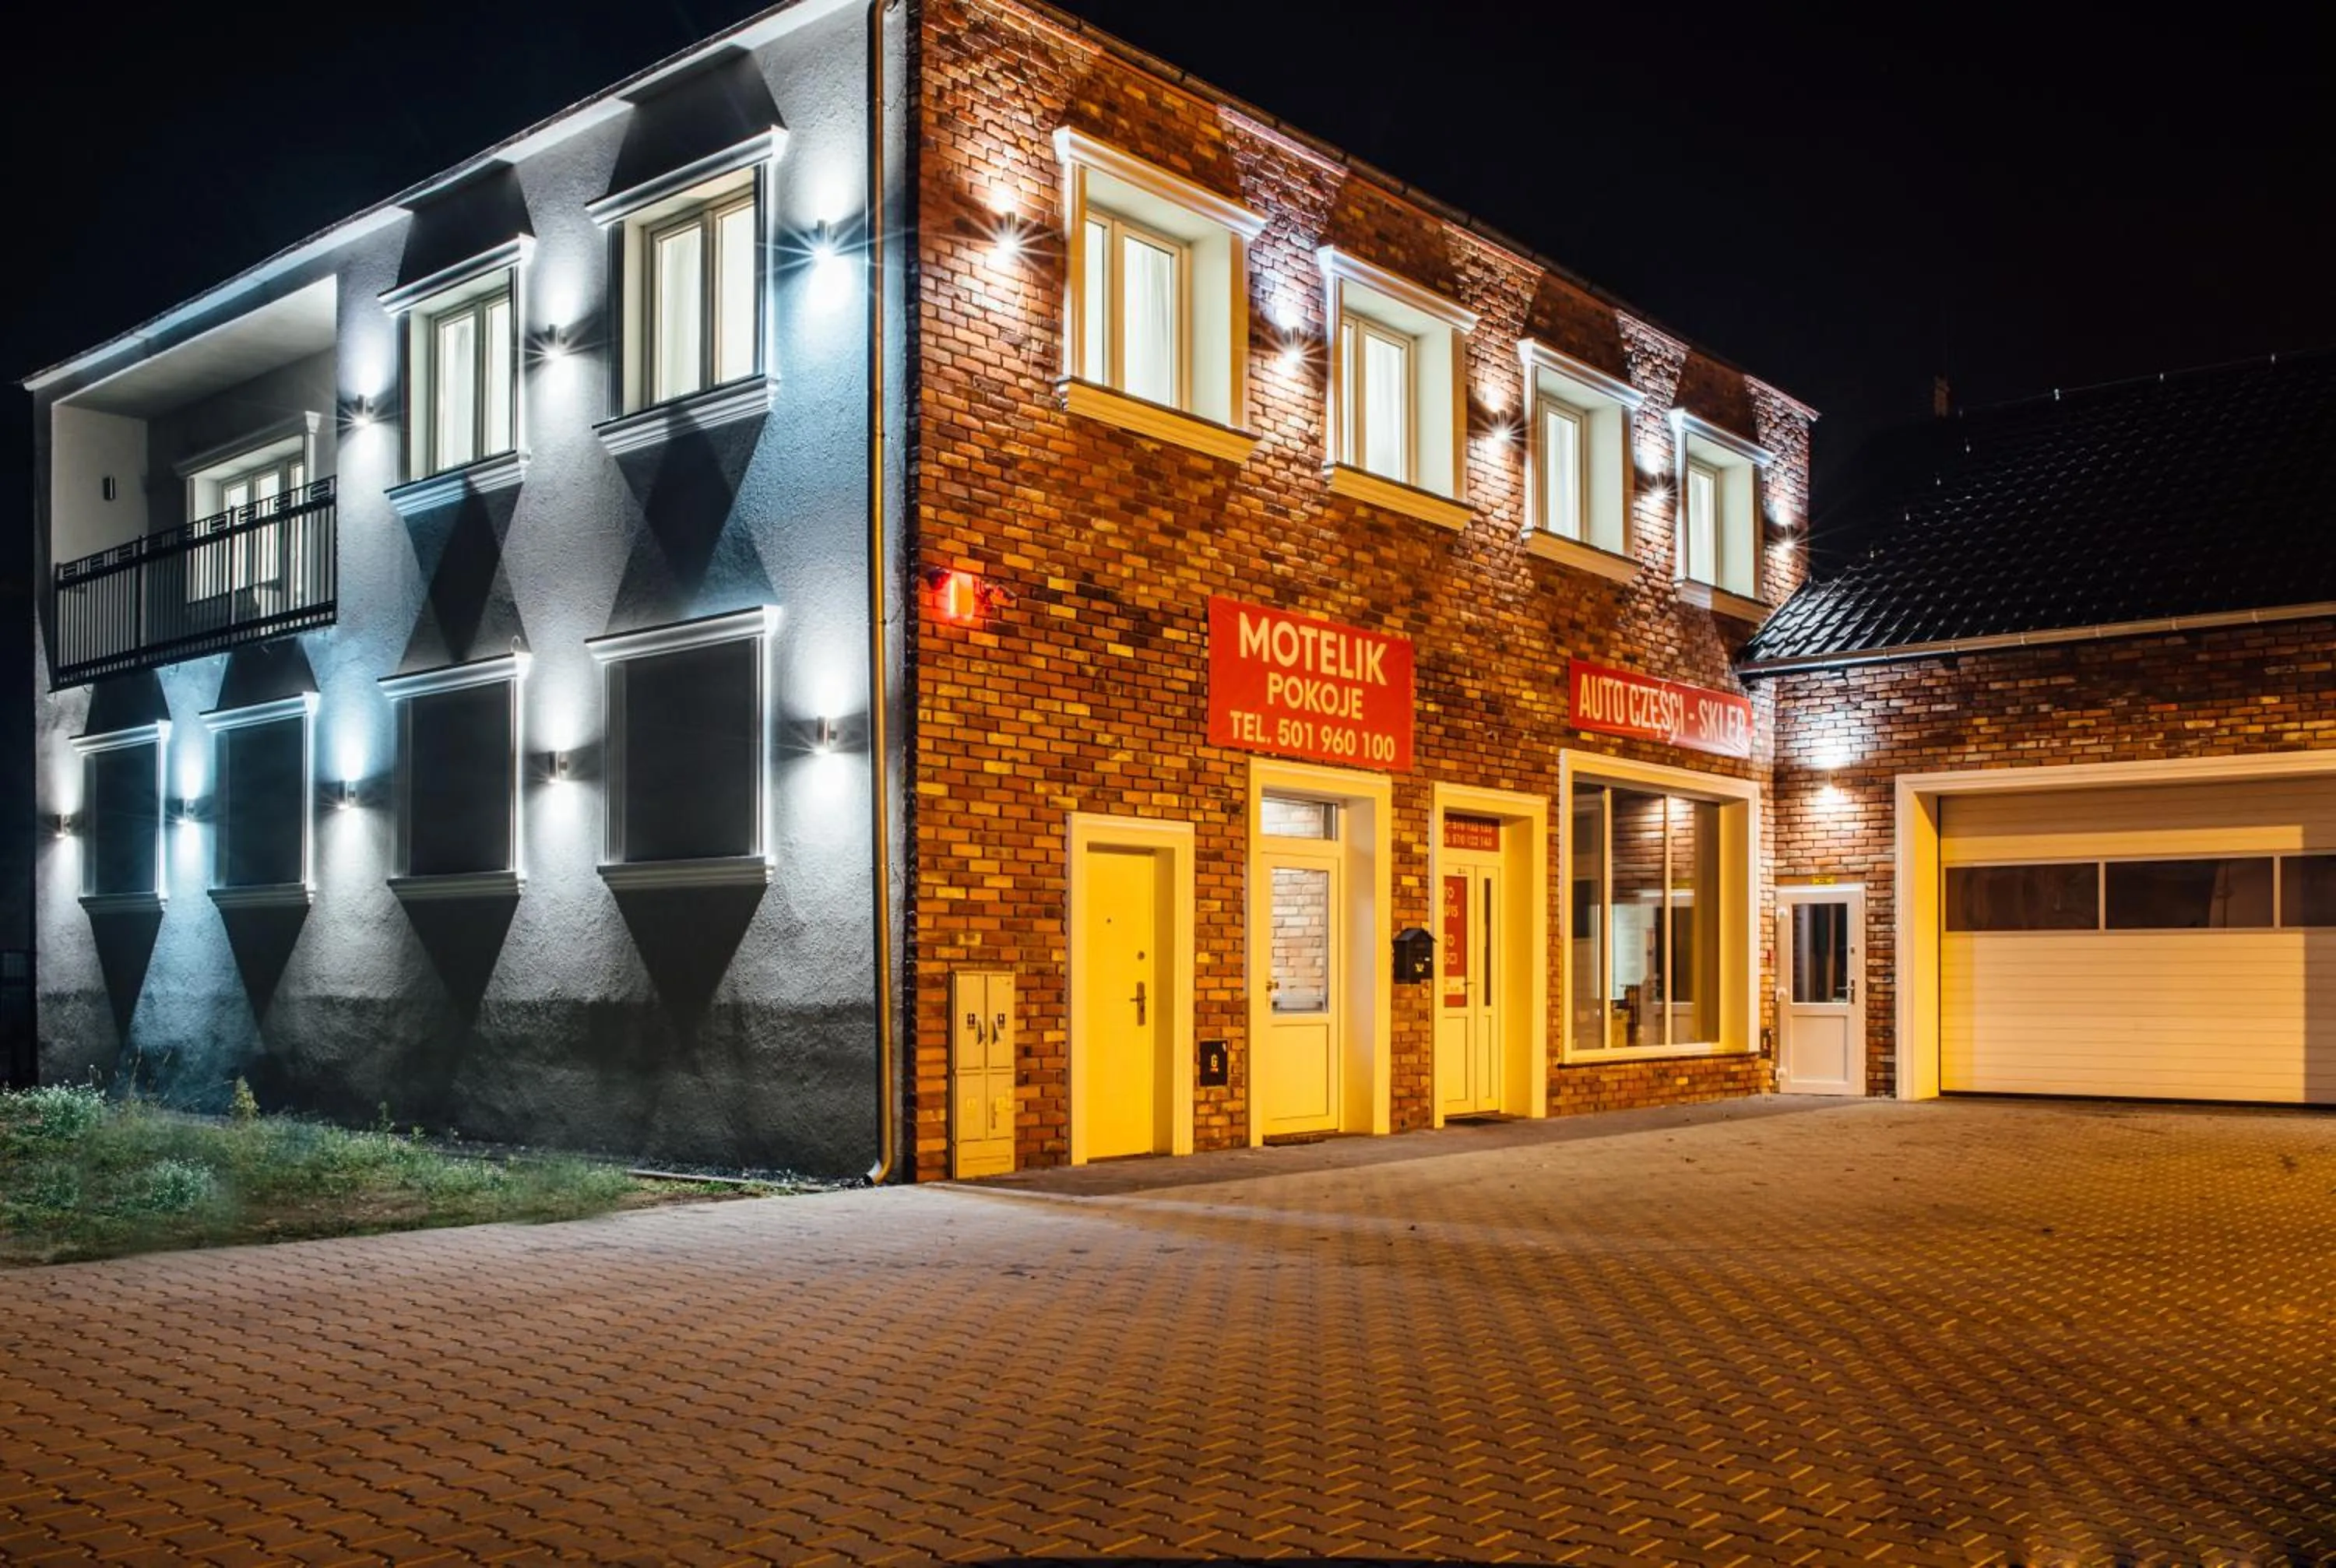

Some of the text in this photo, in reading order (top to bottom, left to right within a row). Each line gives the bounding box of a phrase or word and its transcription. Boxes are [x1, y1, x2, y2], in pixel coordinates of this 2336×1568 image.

[1239, 611, 1387, 686] MOTELIK
[1267, 672, 1363, 720] POKOJE
[1579, 673, 1625, 724] AUTO
[1629, 682, 1684, 738] CZĘŚCI
[1698, 698, 1746, 744] SKLEP
[1230, 710, 1395, 762] TEL. 501 960 100
